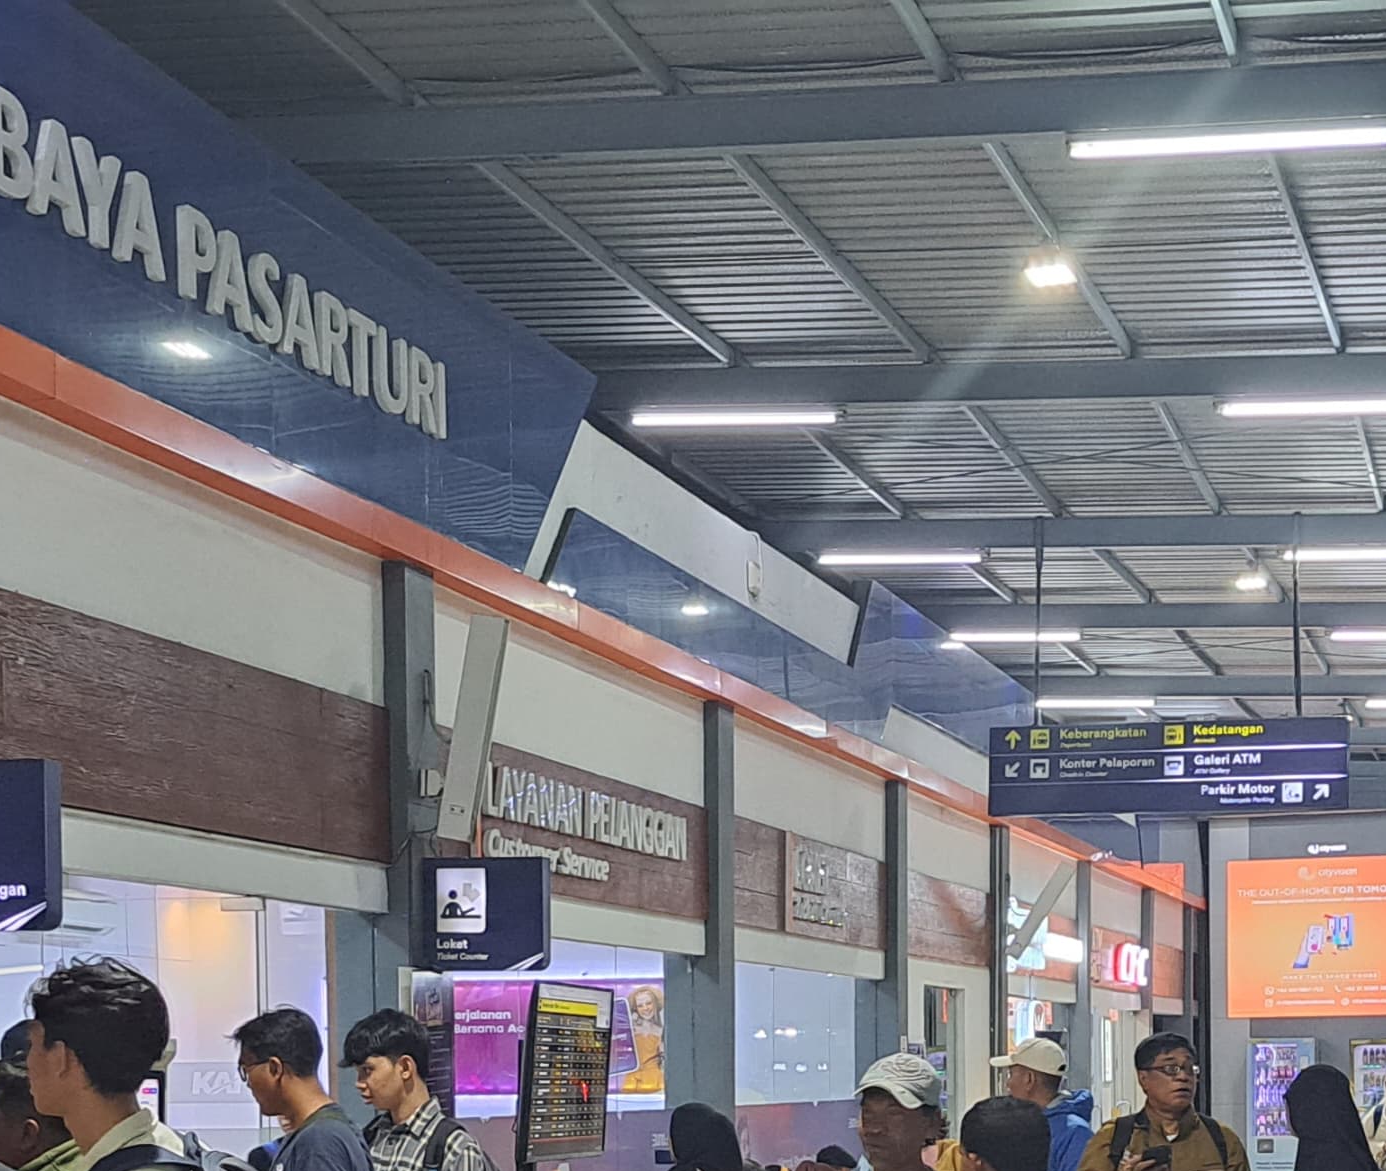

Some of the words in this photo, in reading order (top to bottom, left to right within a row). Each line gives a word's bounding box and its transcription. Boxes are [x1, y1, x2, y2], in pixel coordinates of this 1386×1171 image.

[175, 203, 448, 441] PASARTURI
[1059, 727, 1147, 740] Keberangkatan
[1193, 724, 1264, 737] Kedatangan
[1059, 759, 1098, 769] Konter
[1099, 757, 1155, 769] Pelaporan
[1194, 753, 1231, 766] Galeri
[1232, 752, 1262, 764] ATM
[1200, 783, 1236, 795] Parkir
[1238, 782, 1276, 794] Motor
[481, 761, 583, 837] LAYANAN
[585, 791, 688, 861] PELANGGAN
[557, 846, 610, 881] Service
[1237, 889, 1257, 897] THE
[1259, 887, 1331, 897] OUT-OF-HOME
[1333, 886, 1355, 895] FOR
[436, 938, 469, 950] Loket
[459, 952, 490, 961] Counter
[453, 1010, 512, 1021] erjalanan
